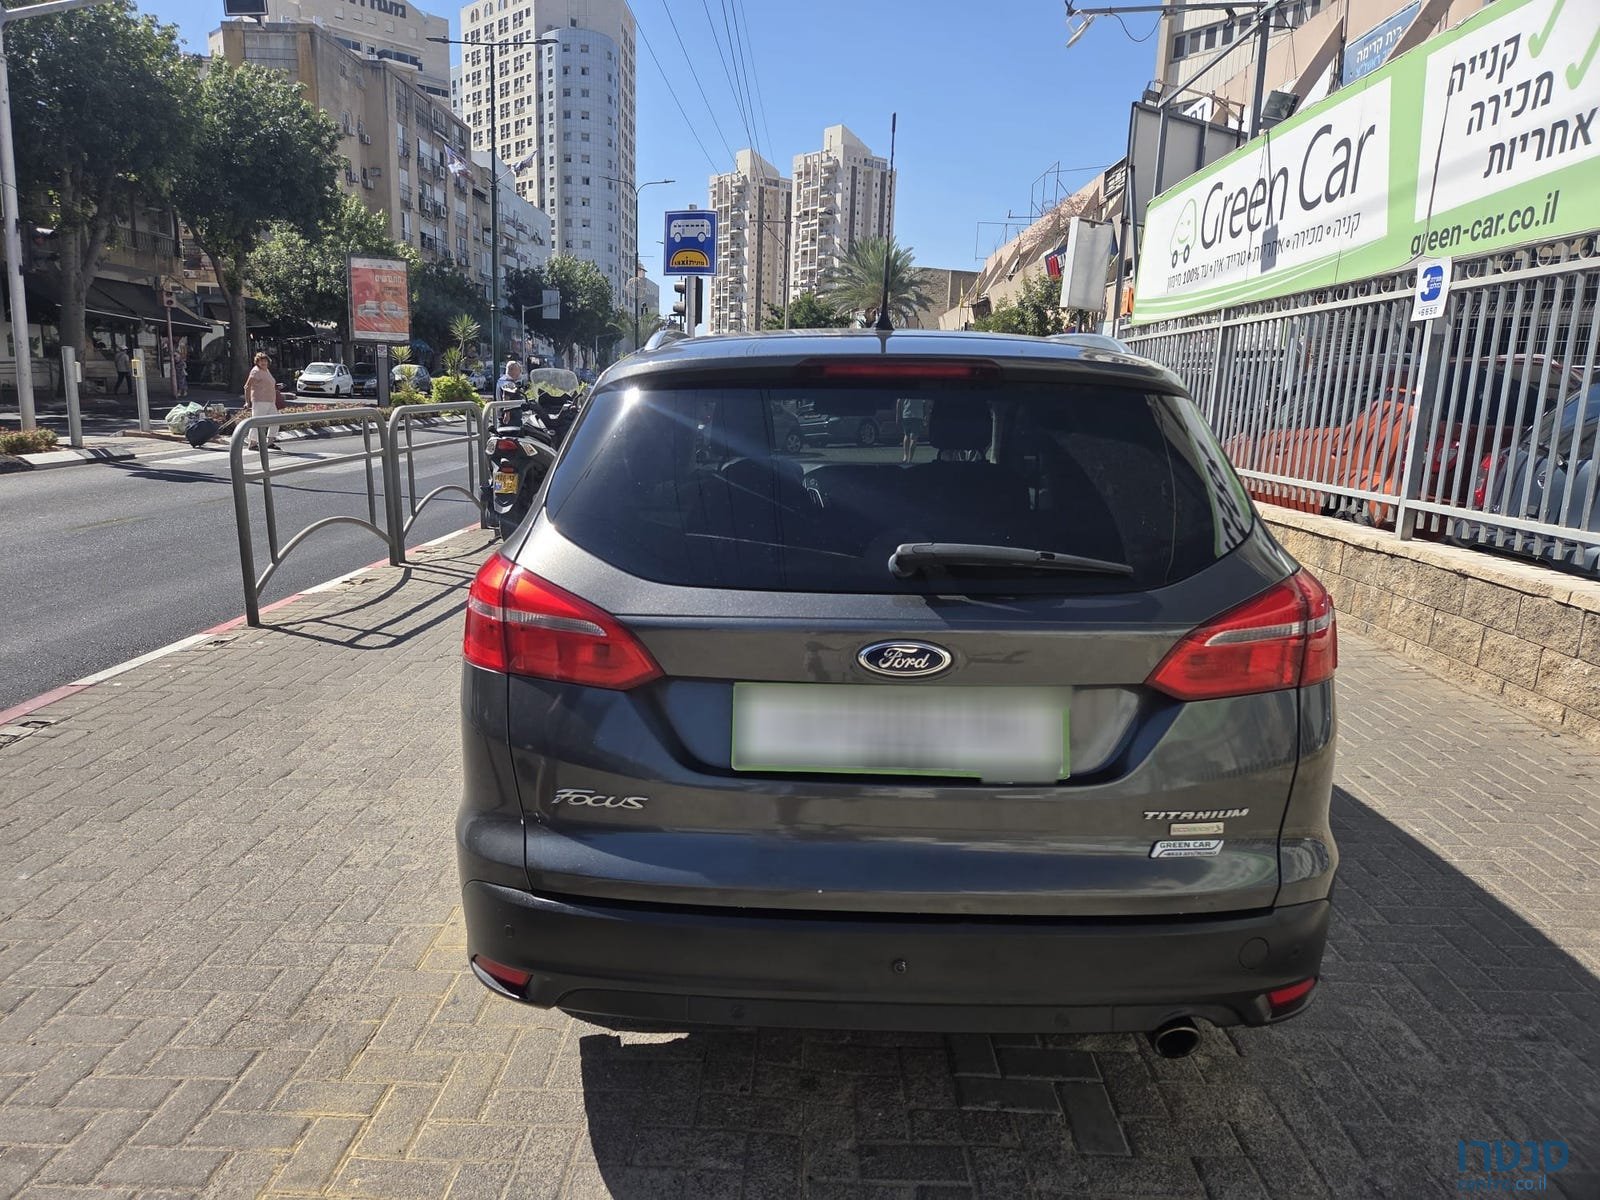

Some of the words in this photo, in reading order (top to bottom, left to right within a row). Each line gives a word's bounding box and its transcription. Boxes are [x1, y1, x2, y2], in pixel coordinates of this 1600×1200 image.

[1356, 36, 1383, 64] קדימה
[1447, 32, 1521, 97] קנייה
[1466, 71, 1554, 136] מכירה
[1483, 106, 1599, 179] אחריות
[1201, 167, 1289, 250] Green
[1299, 124, 1376, 211] Car
[1333, 212, 1360, 239] קניה
[1410, 190, 1560, 259] green-car.co.il
[879, 647, 930, 668] Ford
[1143, 808, 1250, 820] TITANIUM
[1159, 840, 1190, 849] GREEN
[1192, 840, 1211, 848] CAR
